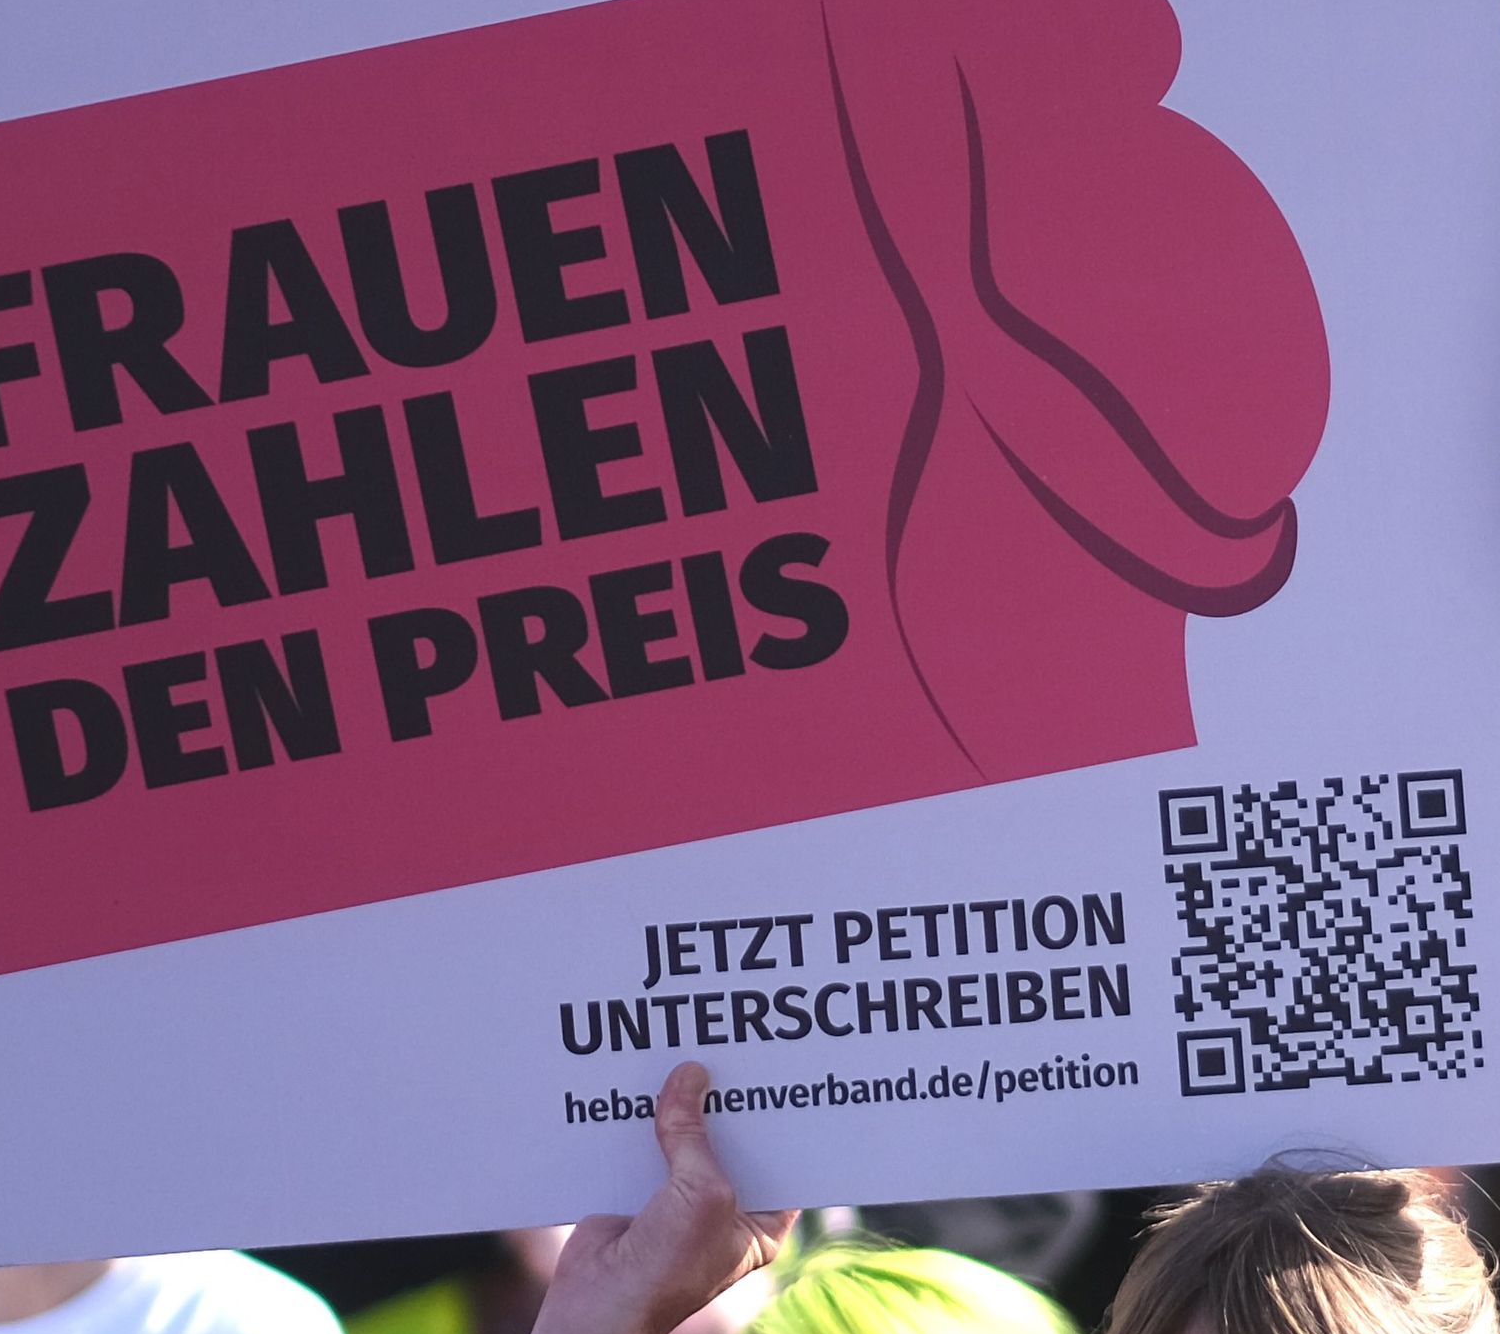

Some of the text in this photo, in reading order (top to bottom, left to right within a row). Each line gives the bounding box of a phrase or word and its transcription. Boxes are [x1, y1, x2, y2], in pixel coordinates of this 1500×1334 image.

[2, 531, 850, 815] DEN PREIS
[642, 892, 1126, 990] JETZT PETITION
[560, 964, 1131, 1056] UNTERSCHREIBEN
